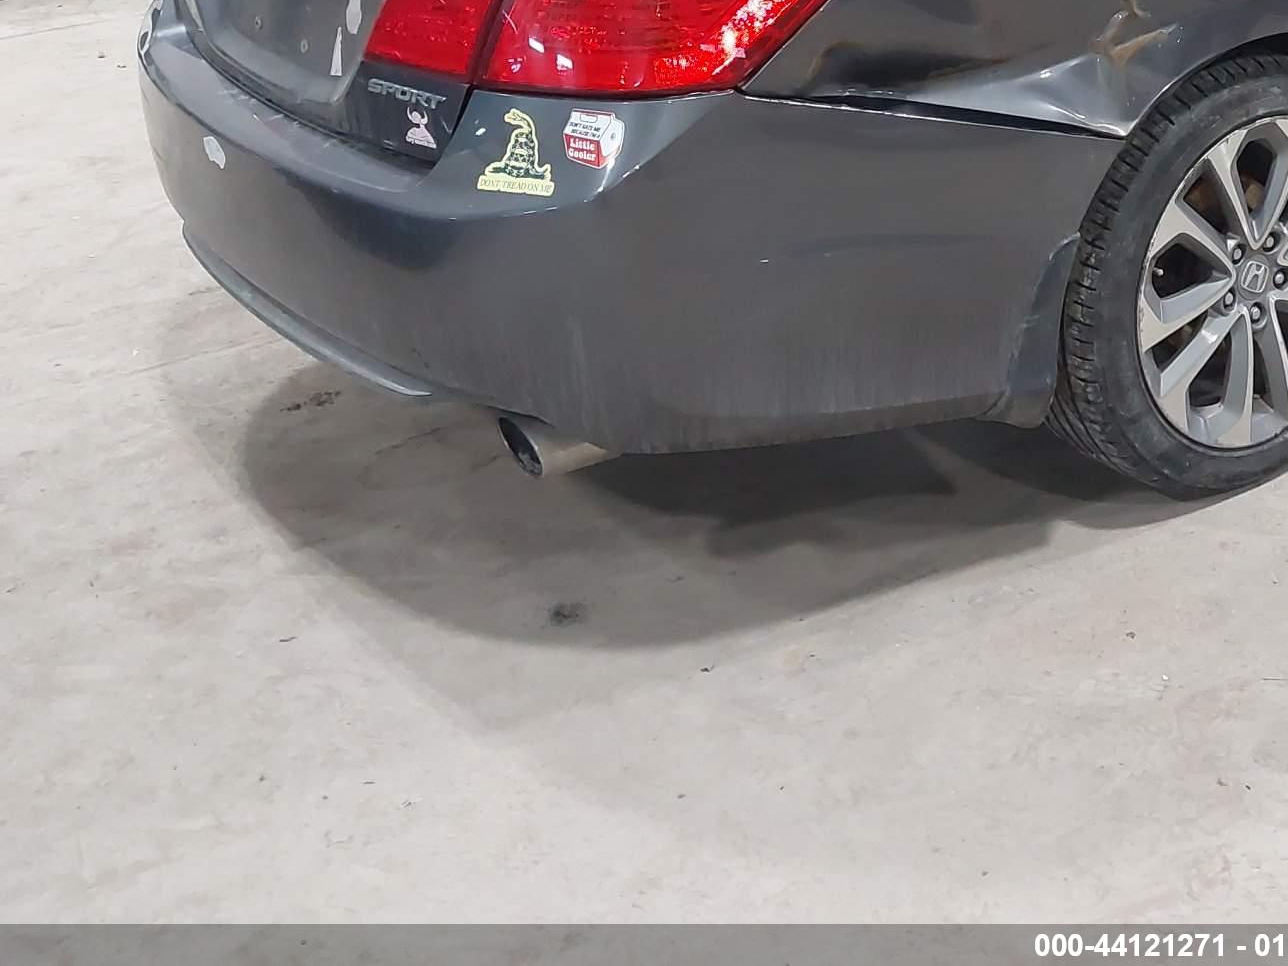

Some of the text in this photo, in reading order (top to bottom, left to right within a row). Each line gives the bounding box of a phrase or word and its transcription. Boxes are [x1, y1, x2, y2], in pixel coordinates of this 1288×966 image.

[367, 78, 447, 109] SPORT
[569, 138, 596, 151] Little
[568, 148, 597, 162] Cooler
[502, 180, 527, 191] TREAD
[527, 183, 539, 191] ON
[540, 184, 553, 193] ME
